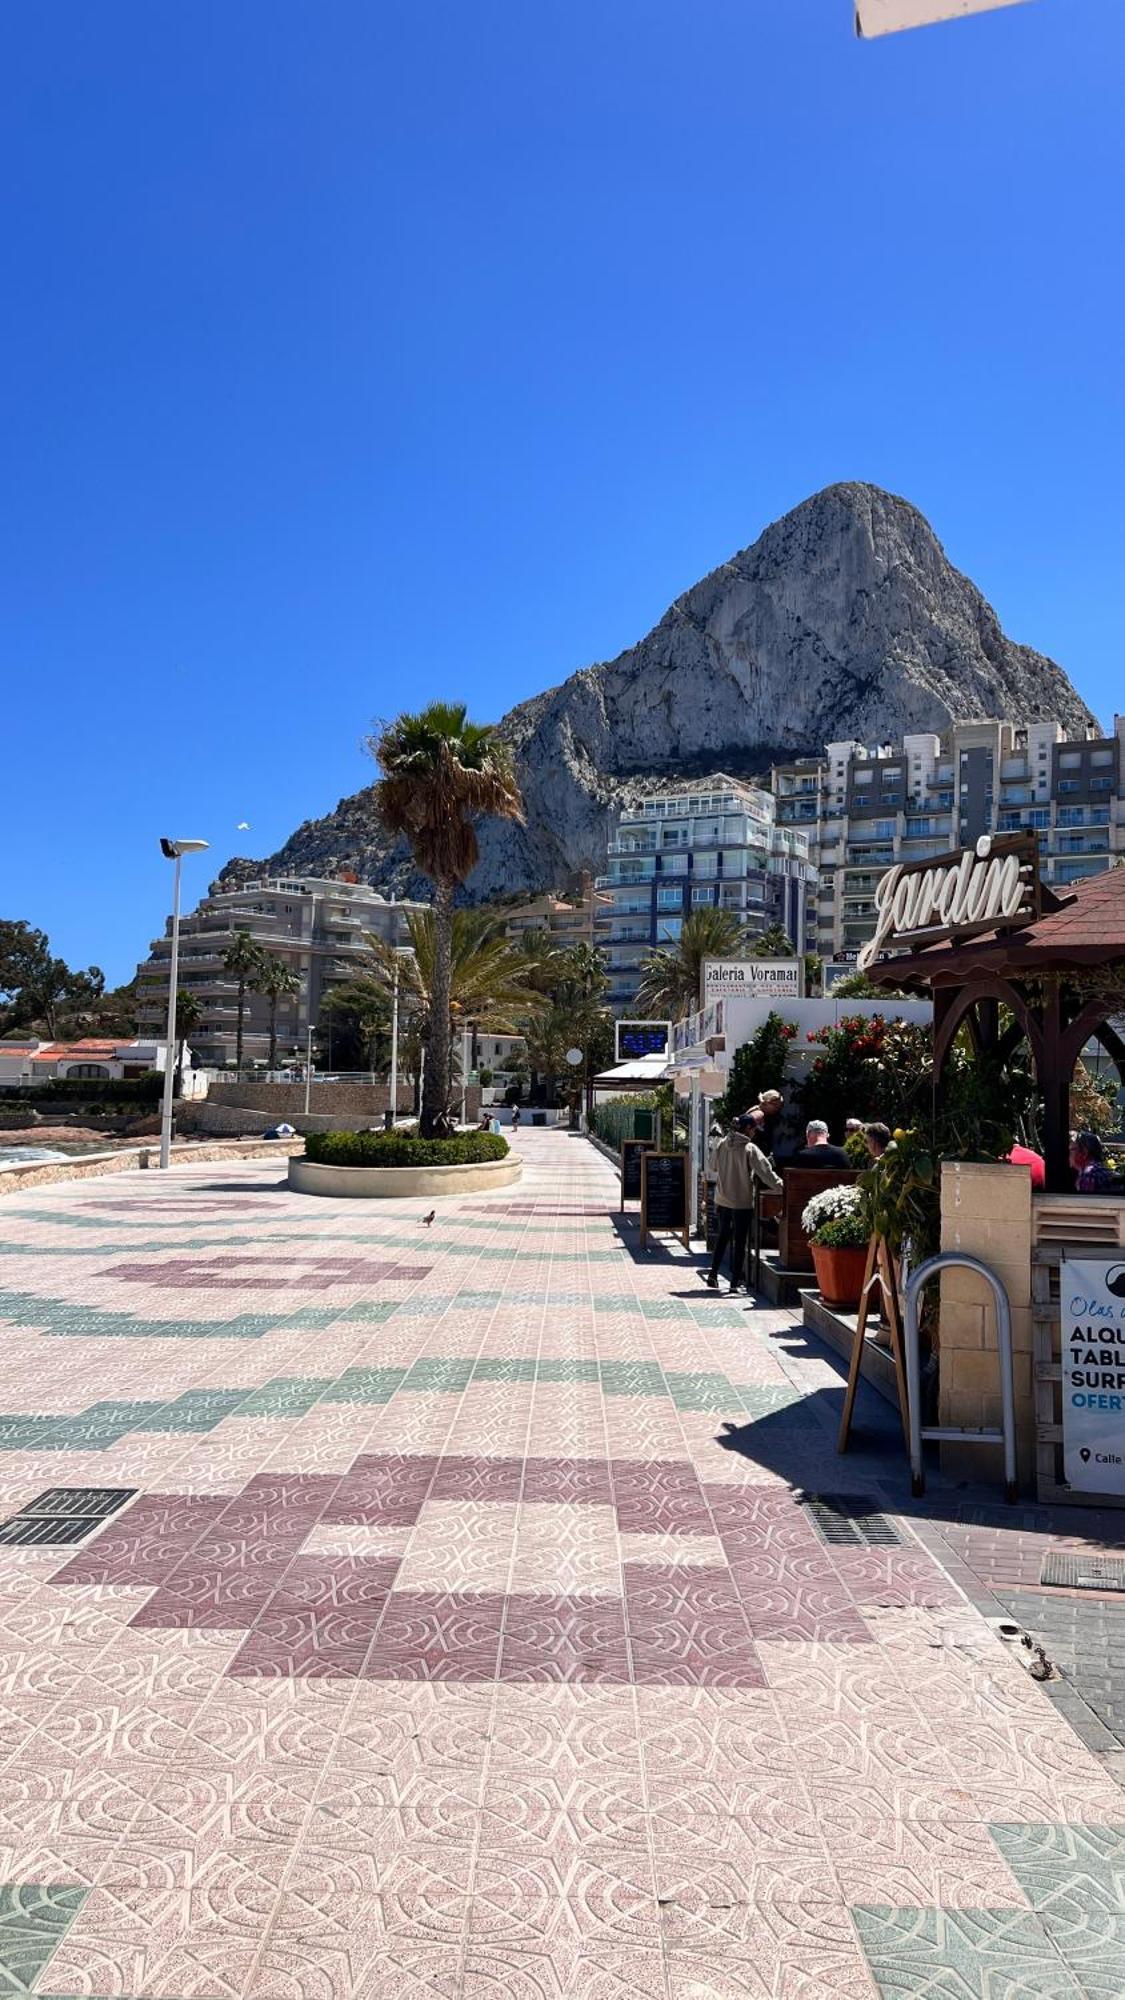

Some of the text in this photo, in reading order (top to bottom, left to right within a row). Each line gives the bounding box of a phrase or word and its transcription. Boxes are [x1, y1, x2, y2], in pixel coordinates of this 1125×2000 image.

[1070, 1296, 1114, 1318] Olas
[1070, 1326, 1125, 1344] ALQU
[1070, 1348, 1125, 1367] TABL
[1095, 1453, 1122, 1464] Calle
